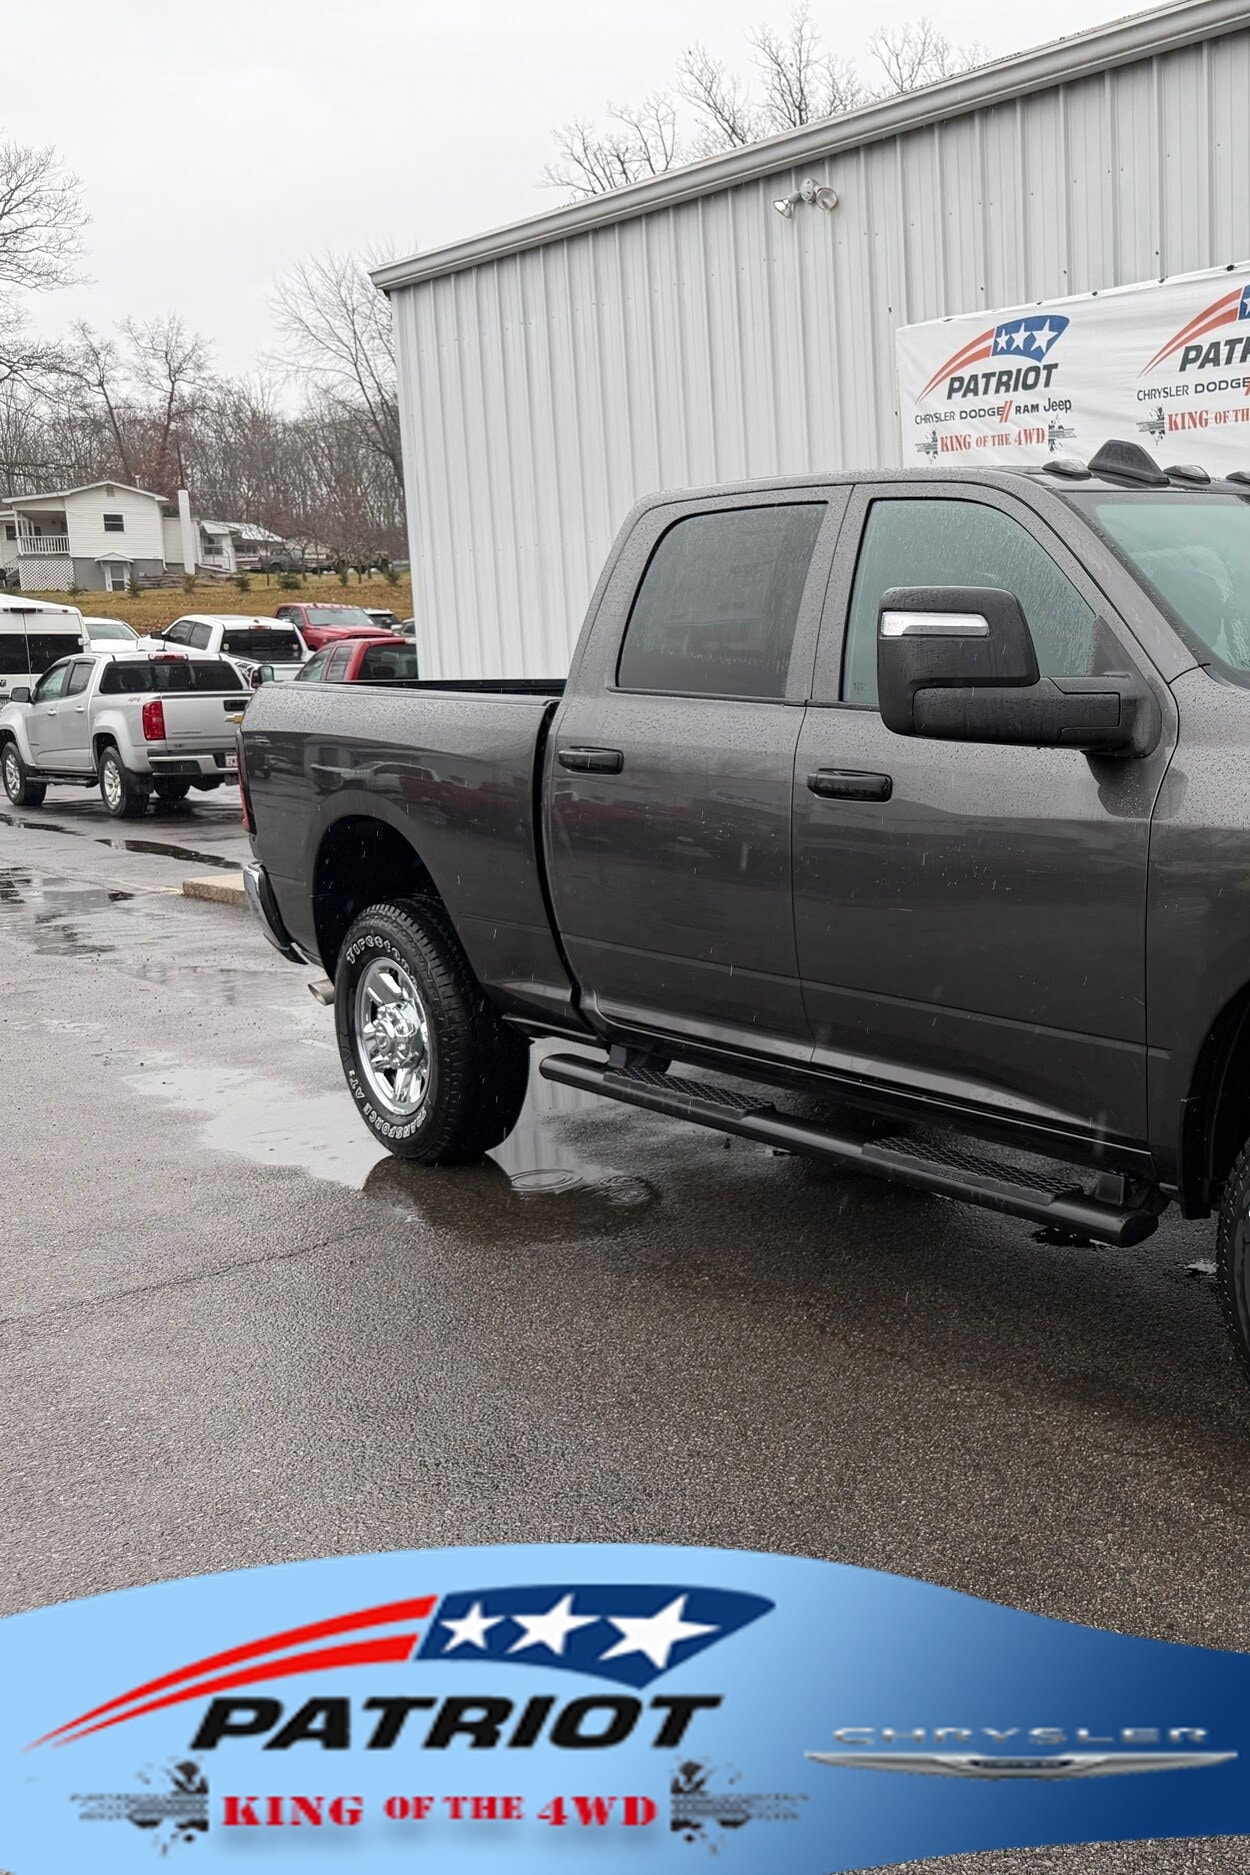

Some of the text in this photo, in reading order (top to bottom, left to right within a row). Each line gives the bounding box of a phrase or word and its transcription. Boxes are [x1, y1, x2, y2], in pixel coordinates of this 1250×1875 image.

[947, 363, 1059, 400] PATRIOT
[1137, 384, 1189, 401] CHRYSLER
[1194, 377, 1250, 394] DODGE
[915, 398, 1072, 425] CHRYSLER DODGE RAM Jeep
[1168, 410, 1209, 432] KING
[1214, 410, 1230, 425] OF
[940, 427, 1045, 453] KING OF THE 4WD
